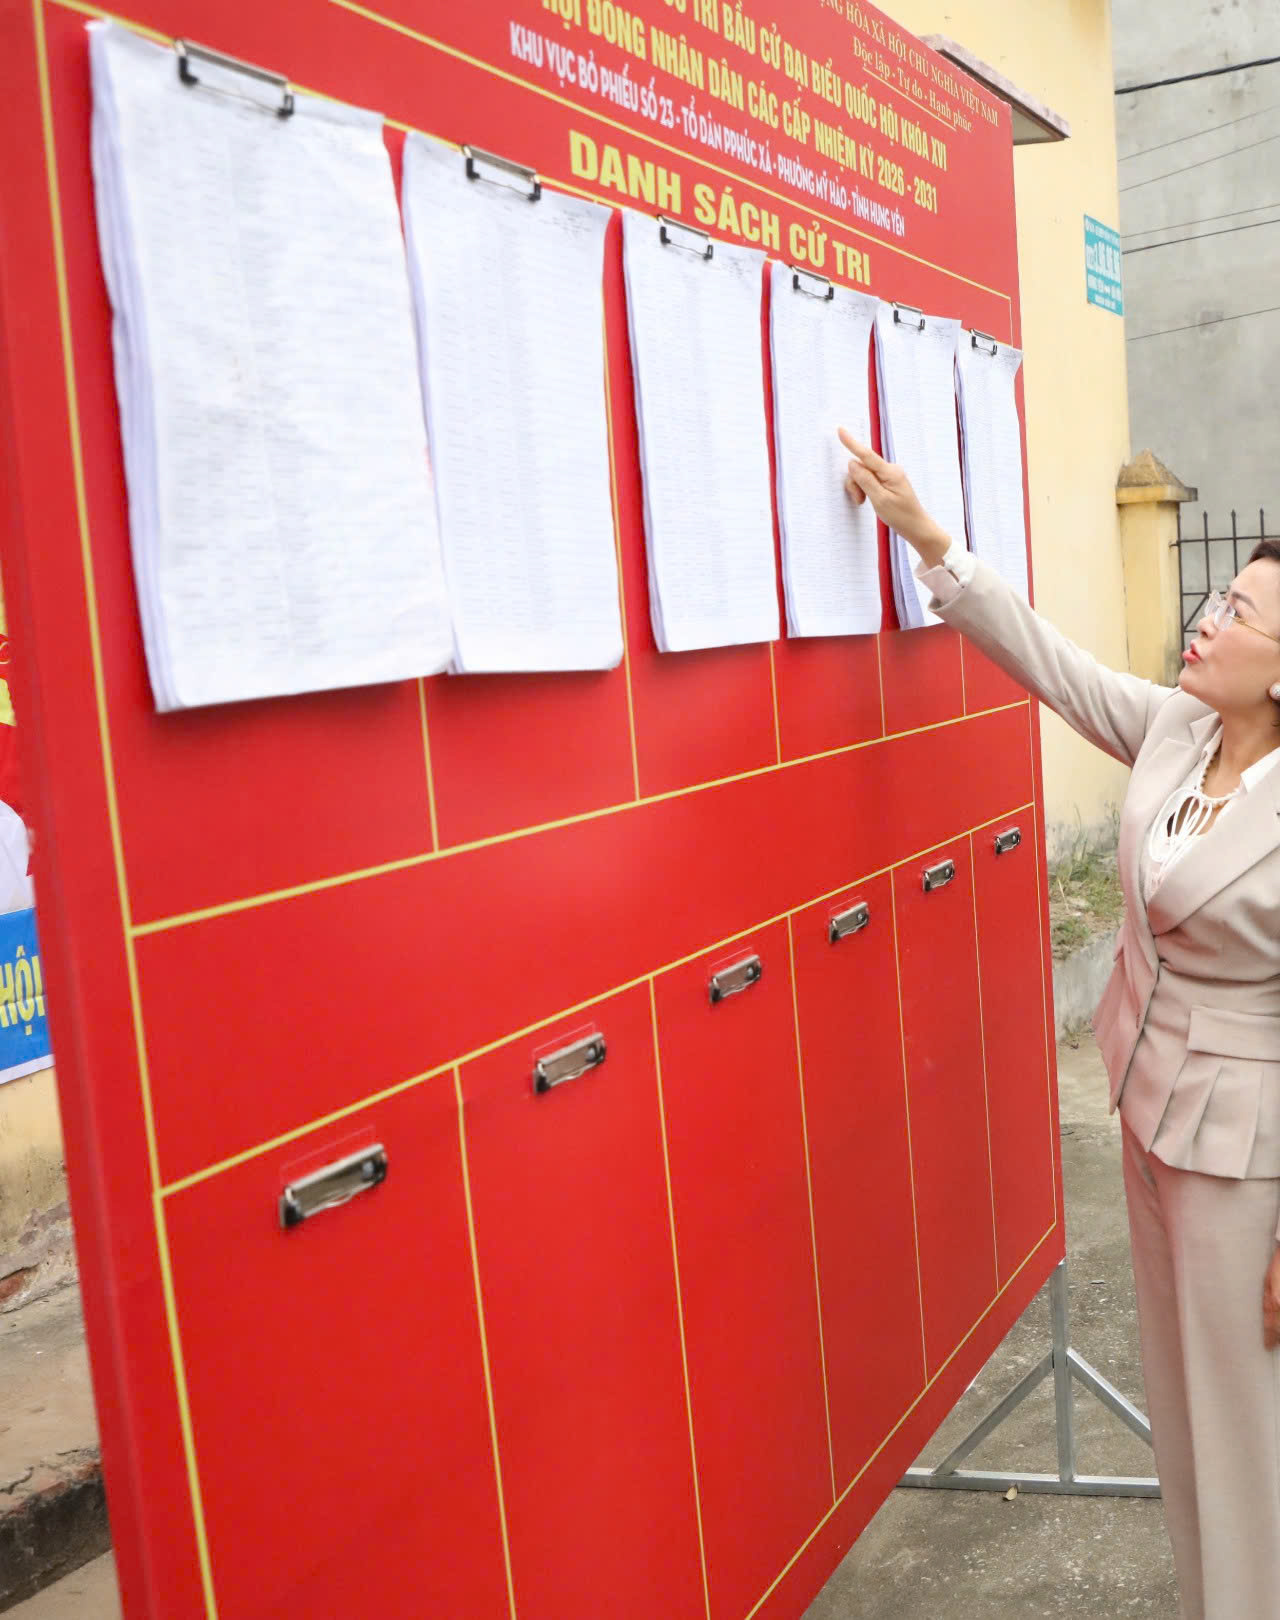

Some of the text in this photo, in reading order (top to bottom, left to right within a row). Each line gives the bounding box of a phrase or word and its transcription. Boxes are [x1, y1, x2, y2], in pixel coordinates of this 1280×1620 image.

[510, 20, 543, 68] KHU
[578, 49, 599, 94] BỎ
[600, 63, 638, 113] PHIẾU
[640, 76, 658, 121] SỐ
[659, 95, 674, 129] 23
[681, 95, 698, 140] TỔ
[829, 175, 847, 211] HÀO
[890, 207, 905, 237] YÊN
[651, 25, 704, 91] NHÂN
[708, 57, 745, 112] DÂN
[748, 80, 779, 129] CÁC
[782, 97, 811, 145] CẤP
[814, 118, 857, 173] NHIỆM
[859, 141, 875, 181] KỲ
[877, 155, 905, 197] 2026
[913, 176, 938, 215] 2031
[722, 0, 756, 55] BẦU
[760, 22, 781, 70] CỬ
[783, 41, 809, 92] ĐẠI
[811, 57, 842, 108] BIỂU
[845, 81, 877, 129] QUỐC
[879, 103, 899, 146] HỘI
[901, 117, 929, 161] KHÓA
[931, 136, 948, 172] XVI
[846, 1, 871, 36] HÒA
[871, 19, 886, 47] XÃ
[888, 32, 907, 62] HỘI
[909, 48, 929, 78] CHỦ
[960, 85, 980, 115] VIỆT
[981, 101, 998, 128] NAM
[853, 35, 873, 67] Độc
[875, 51, 891, 81] lập
[897, 66, 910, 96] Tự
[912, 78, 923, 100] do
[929, 89, 952, 120] Hạnh
[953, 110, 972, 133] phúc
[569, 129, 871, 286] DANH SÁCH CỬ TRI
